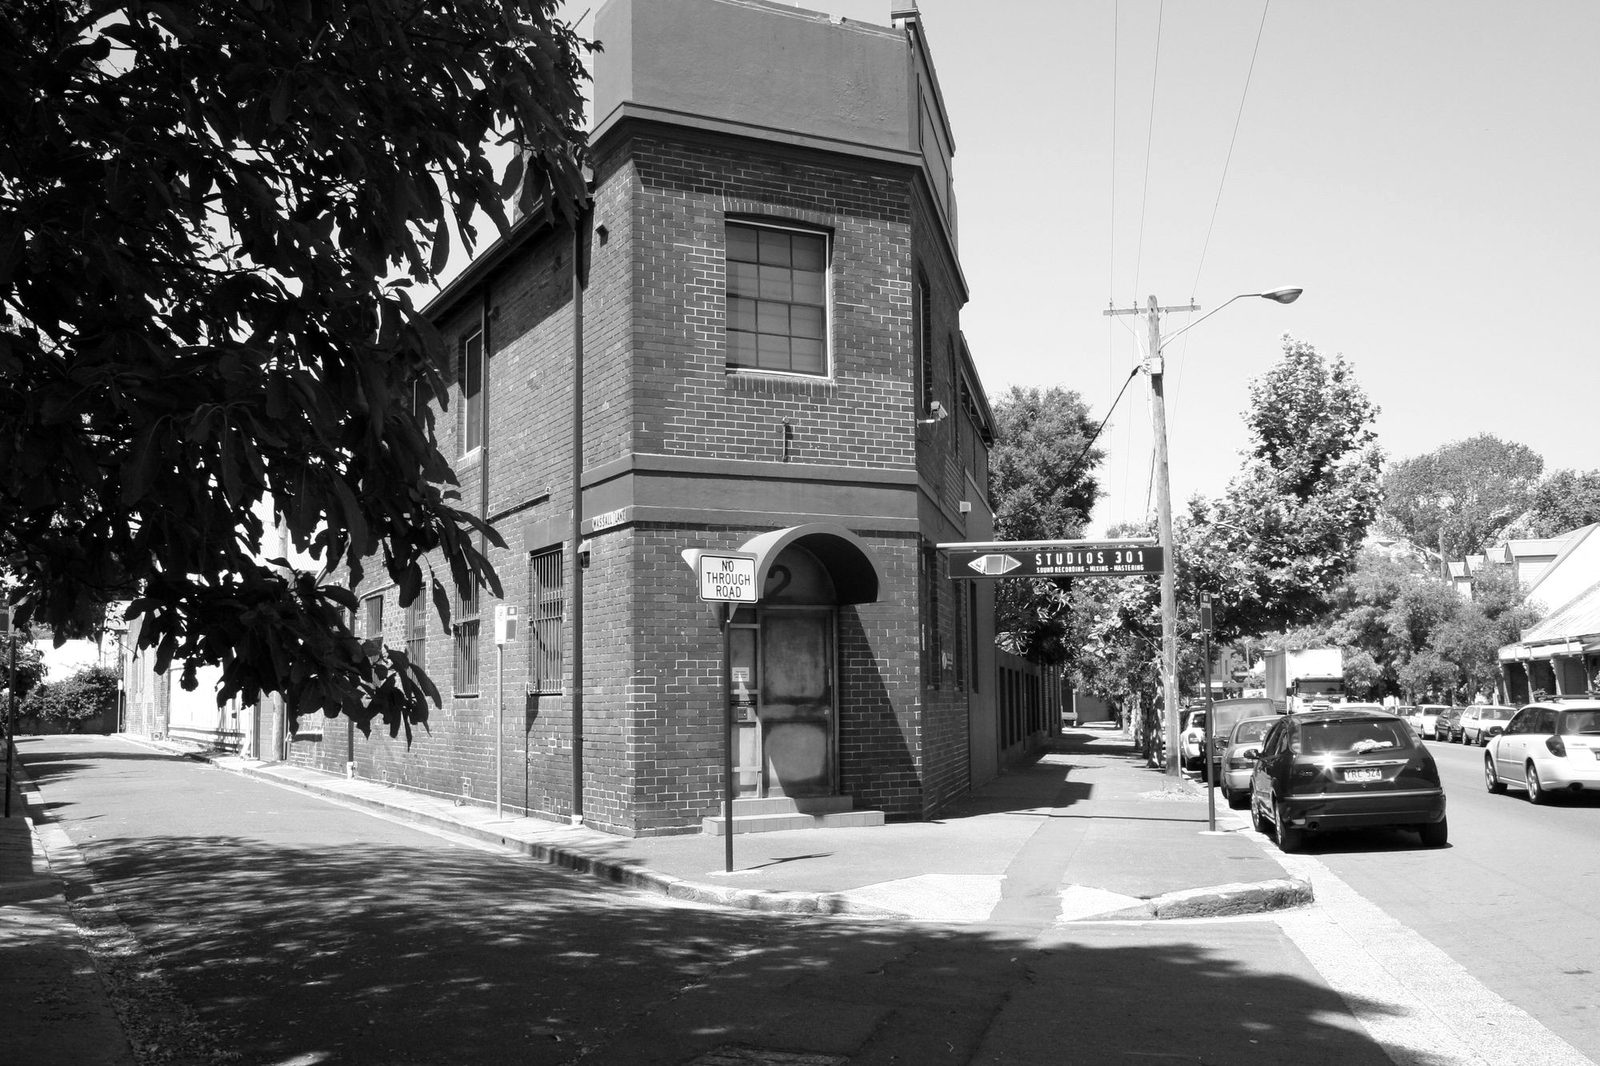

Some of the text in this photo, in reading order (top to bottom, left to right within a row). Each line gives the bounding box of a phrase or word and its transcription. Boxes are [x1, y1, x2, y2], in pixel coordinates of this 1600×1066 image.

[1035, 550, 1144, 565] STUDIOS 301
[721, 560, 735, 572] NO
[1054, 565, 1085, 573] RECORDING
[706, 571, 751, 586] THROUGH
[716, 585, 742, 598] ROAD
